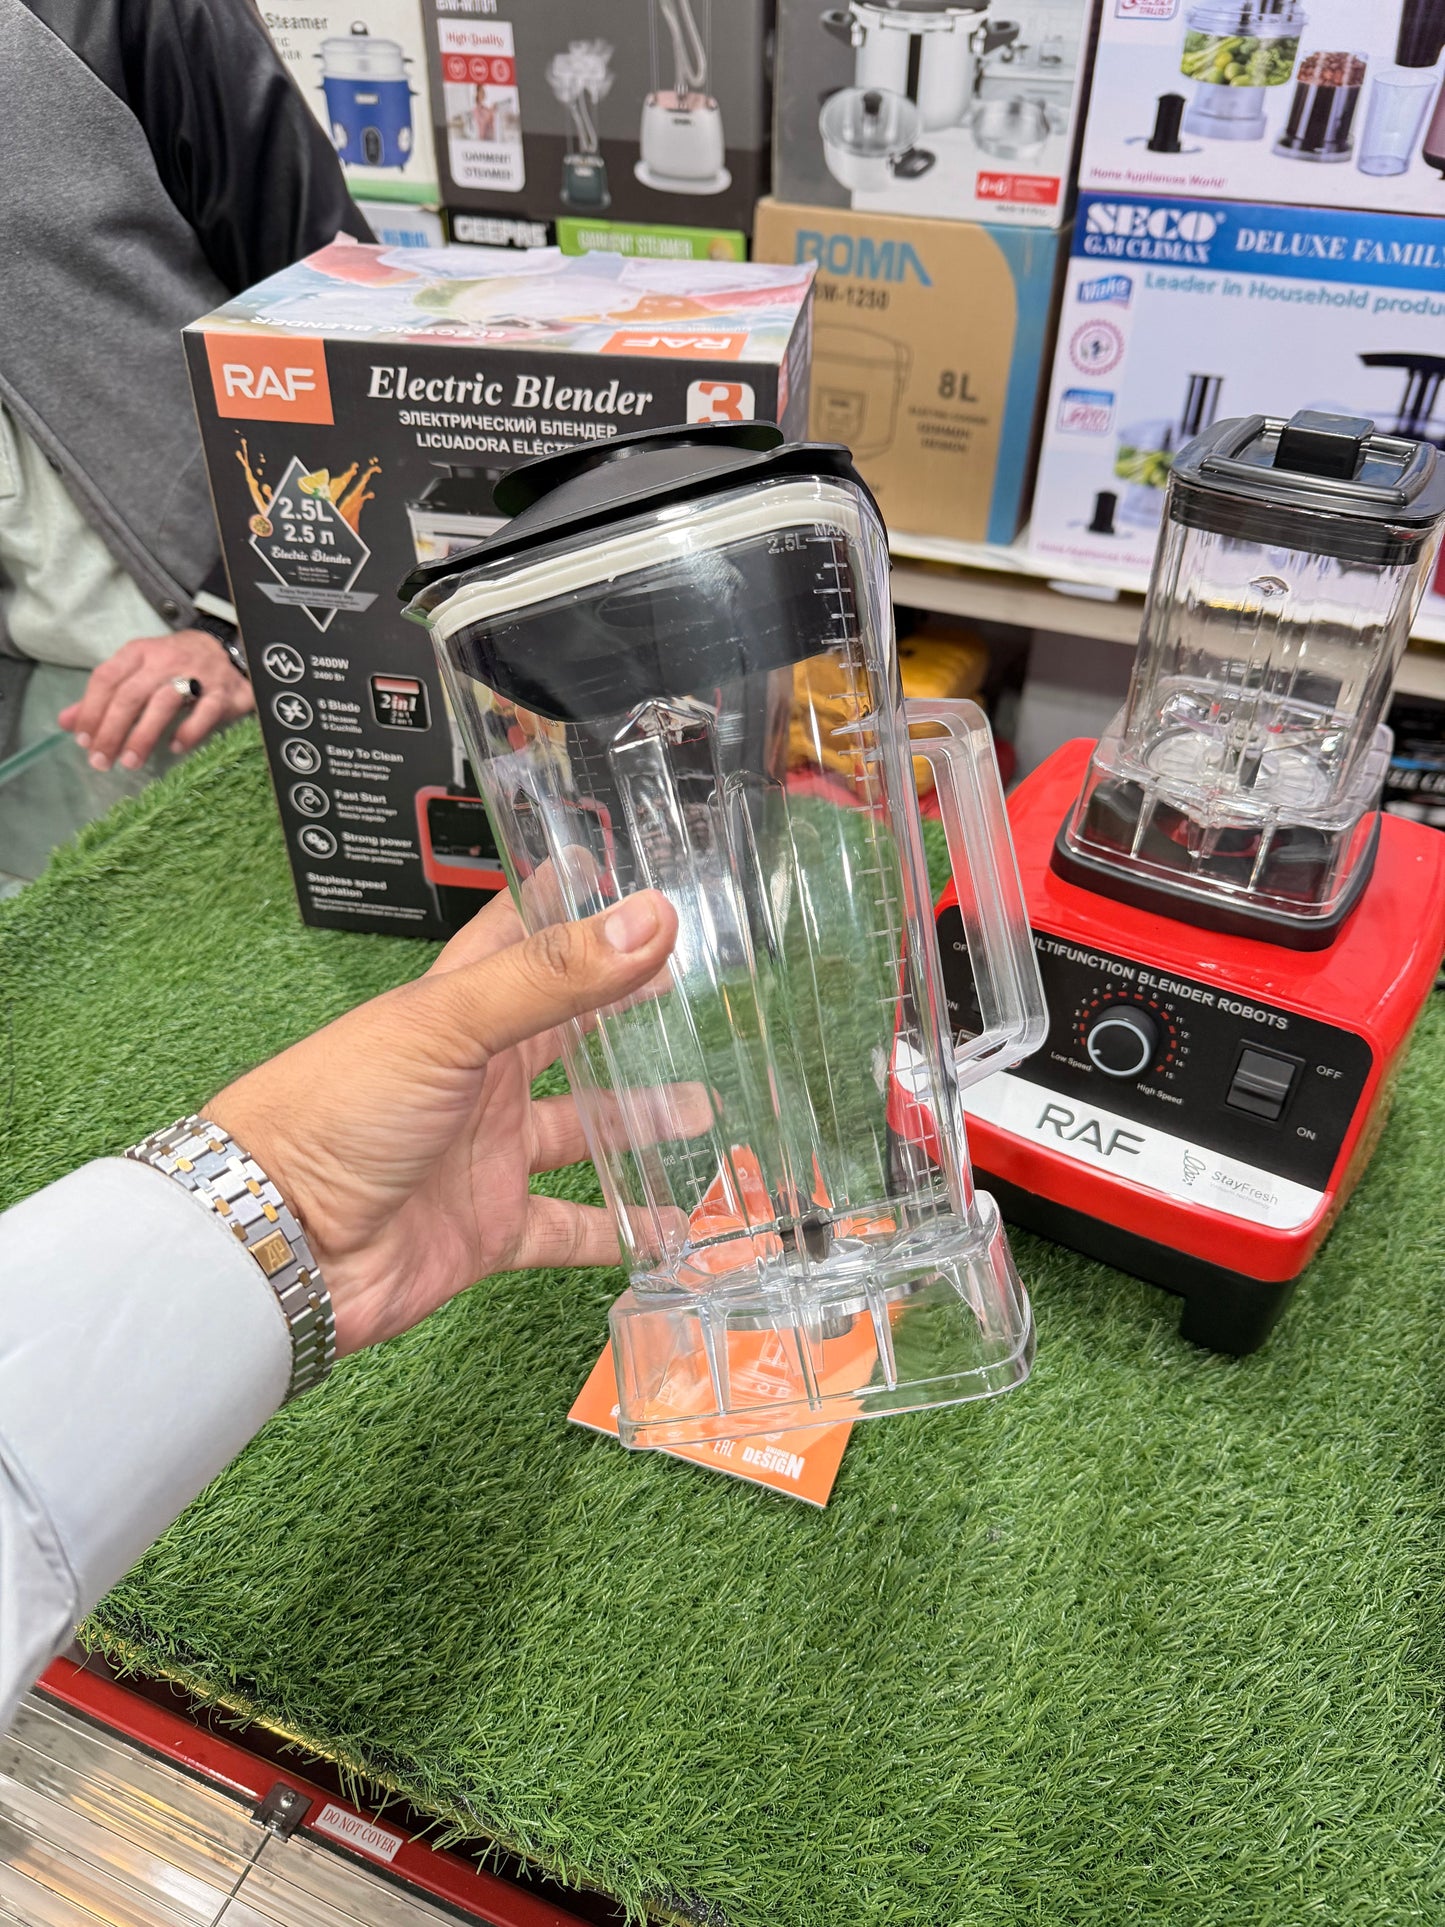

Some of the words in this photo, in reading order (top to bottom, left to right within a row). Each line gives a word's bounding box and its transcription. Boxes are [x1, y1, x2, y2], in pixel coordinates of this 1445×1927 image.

[265, 12, 328, 29] Steamer
[1086, 202, 1217, 243] SECO
[1235, 228, 1348, 260] DELUXE
[1144, 272, 1217, 294] Leader
[1221, 278, 1242, 297] in
[1249, 279, 1369, 309] Household
[250, 316, 372, 333] BLENDER
[621, 336, 732, 349] RAF
[222, 363, 316, 401] RAF
[367, 365, 501, 405] Electric
[512, 374, 653, 416] Blender
[938, 370, 976, 403] 8L
[399, 410, 537, 434] ЭЛЕКТРИЧЕСКИЙ
[540, 420, 618, 440] БЛЕНДЕР
[416, 433, 510, 453] LICUADORA
[513, 438, 577, 456] ELÉCT
[279, 497, 334, 523] 2.5L
[283, 523, 315, 544] 2.5
[814, 523, 845, 537] MAX
[767, 532, 807, 554] 2.5L
[271, 546, 308, 561] Electric
[311, 549, 352, 565] Blender
[310, 655, 349, 670] 2400W
[318, 698, 326, 709] 6
[328, 699, 361, 713] Blade
[325, 744, 354, 760] Easy
[356, 747, 370, 760] To
[371, 749, 404, 763] Clean
[334, 789, 359, 801] Fast
[360, 791, 387, 804] Start
[341, 831, 378, 847] Strong
[379, 836, 413, 848] power
[306, 872, 353, 887] Stepless
[354, 879, 387, 891] speed
[309, 884, 363, 898] regulation
[953, 941, 968, 951] OF
[1034, 937, 1135, 979] LTIFUNCTION
[1138, 971, 1213, 1006] BLENDER
[1217, 997, 1288, 1030] ROBOTS
[1050, 1051, 1067, 1064] Low
[1067, 1057, 1093, 1072] Speed
[1315, 1064, 1344, 1081] OFF
[1136, 1083, 1155, 1096] High
[1156, 1089, 1184, 1105] Speed
[1035, 1102, 1147, 1156] RAF
[1296, 1126, 1316, 1141] ON
[1211, 1170, 1278, 1206] StayFresh
[741, 1446, 805, 1480] DESIGN
[323, 1808, 338, 1824] DO
[340, 1816, 362, 1835] NOT
[361, 1827, 397, 1853] COVER
